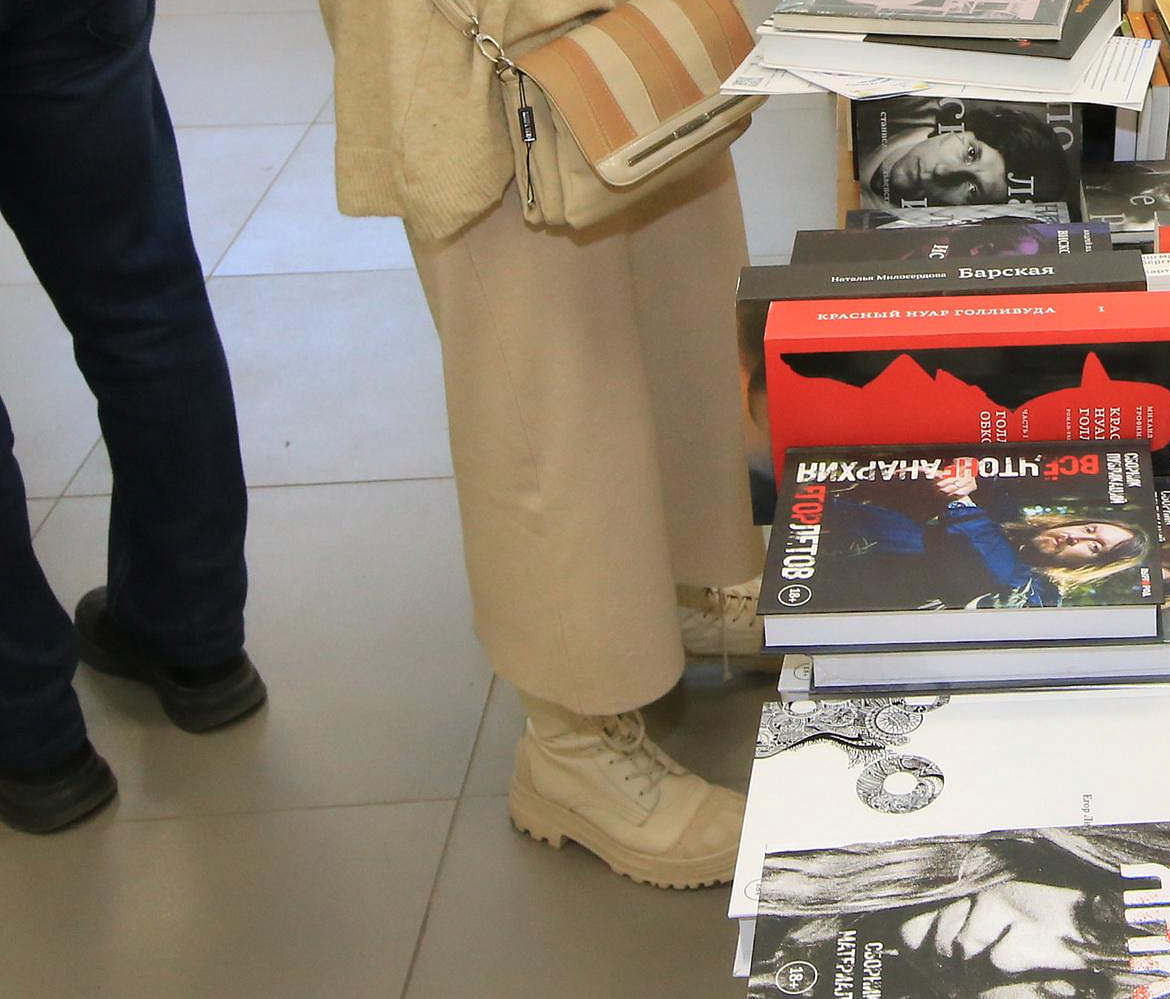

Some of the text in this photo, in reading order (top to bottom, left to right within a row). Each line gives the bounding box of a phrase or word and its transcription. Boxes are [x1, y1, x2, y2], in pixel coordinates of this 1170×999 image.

[831, 265, 1055, 283] Наталья Милосердова Барская
[816, 305, 1057, 321] КРАСНЫЙ НУАР ГОЛЛИВУДА
[781, 524, 822, 580] ЛЕТОВ
[788, 587, 803, 605] 18+
[786, 965, 805, 991] 18+
